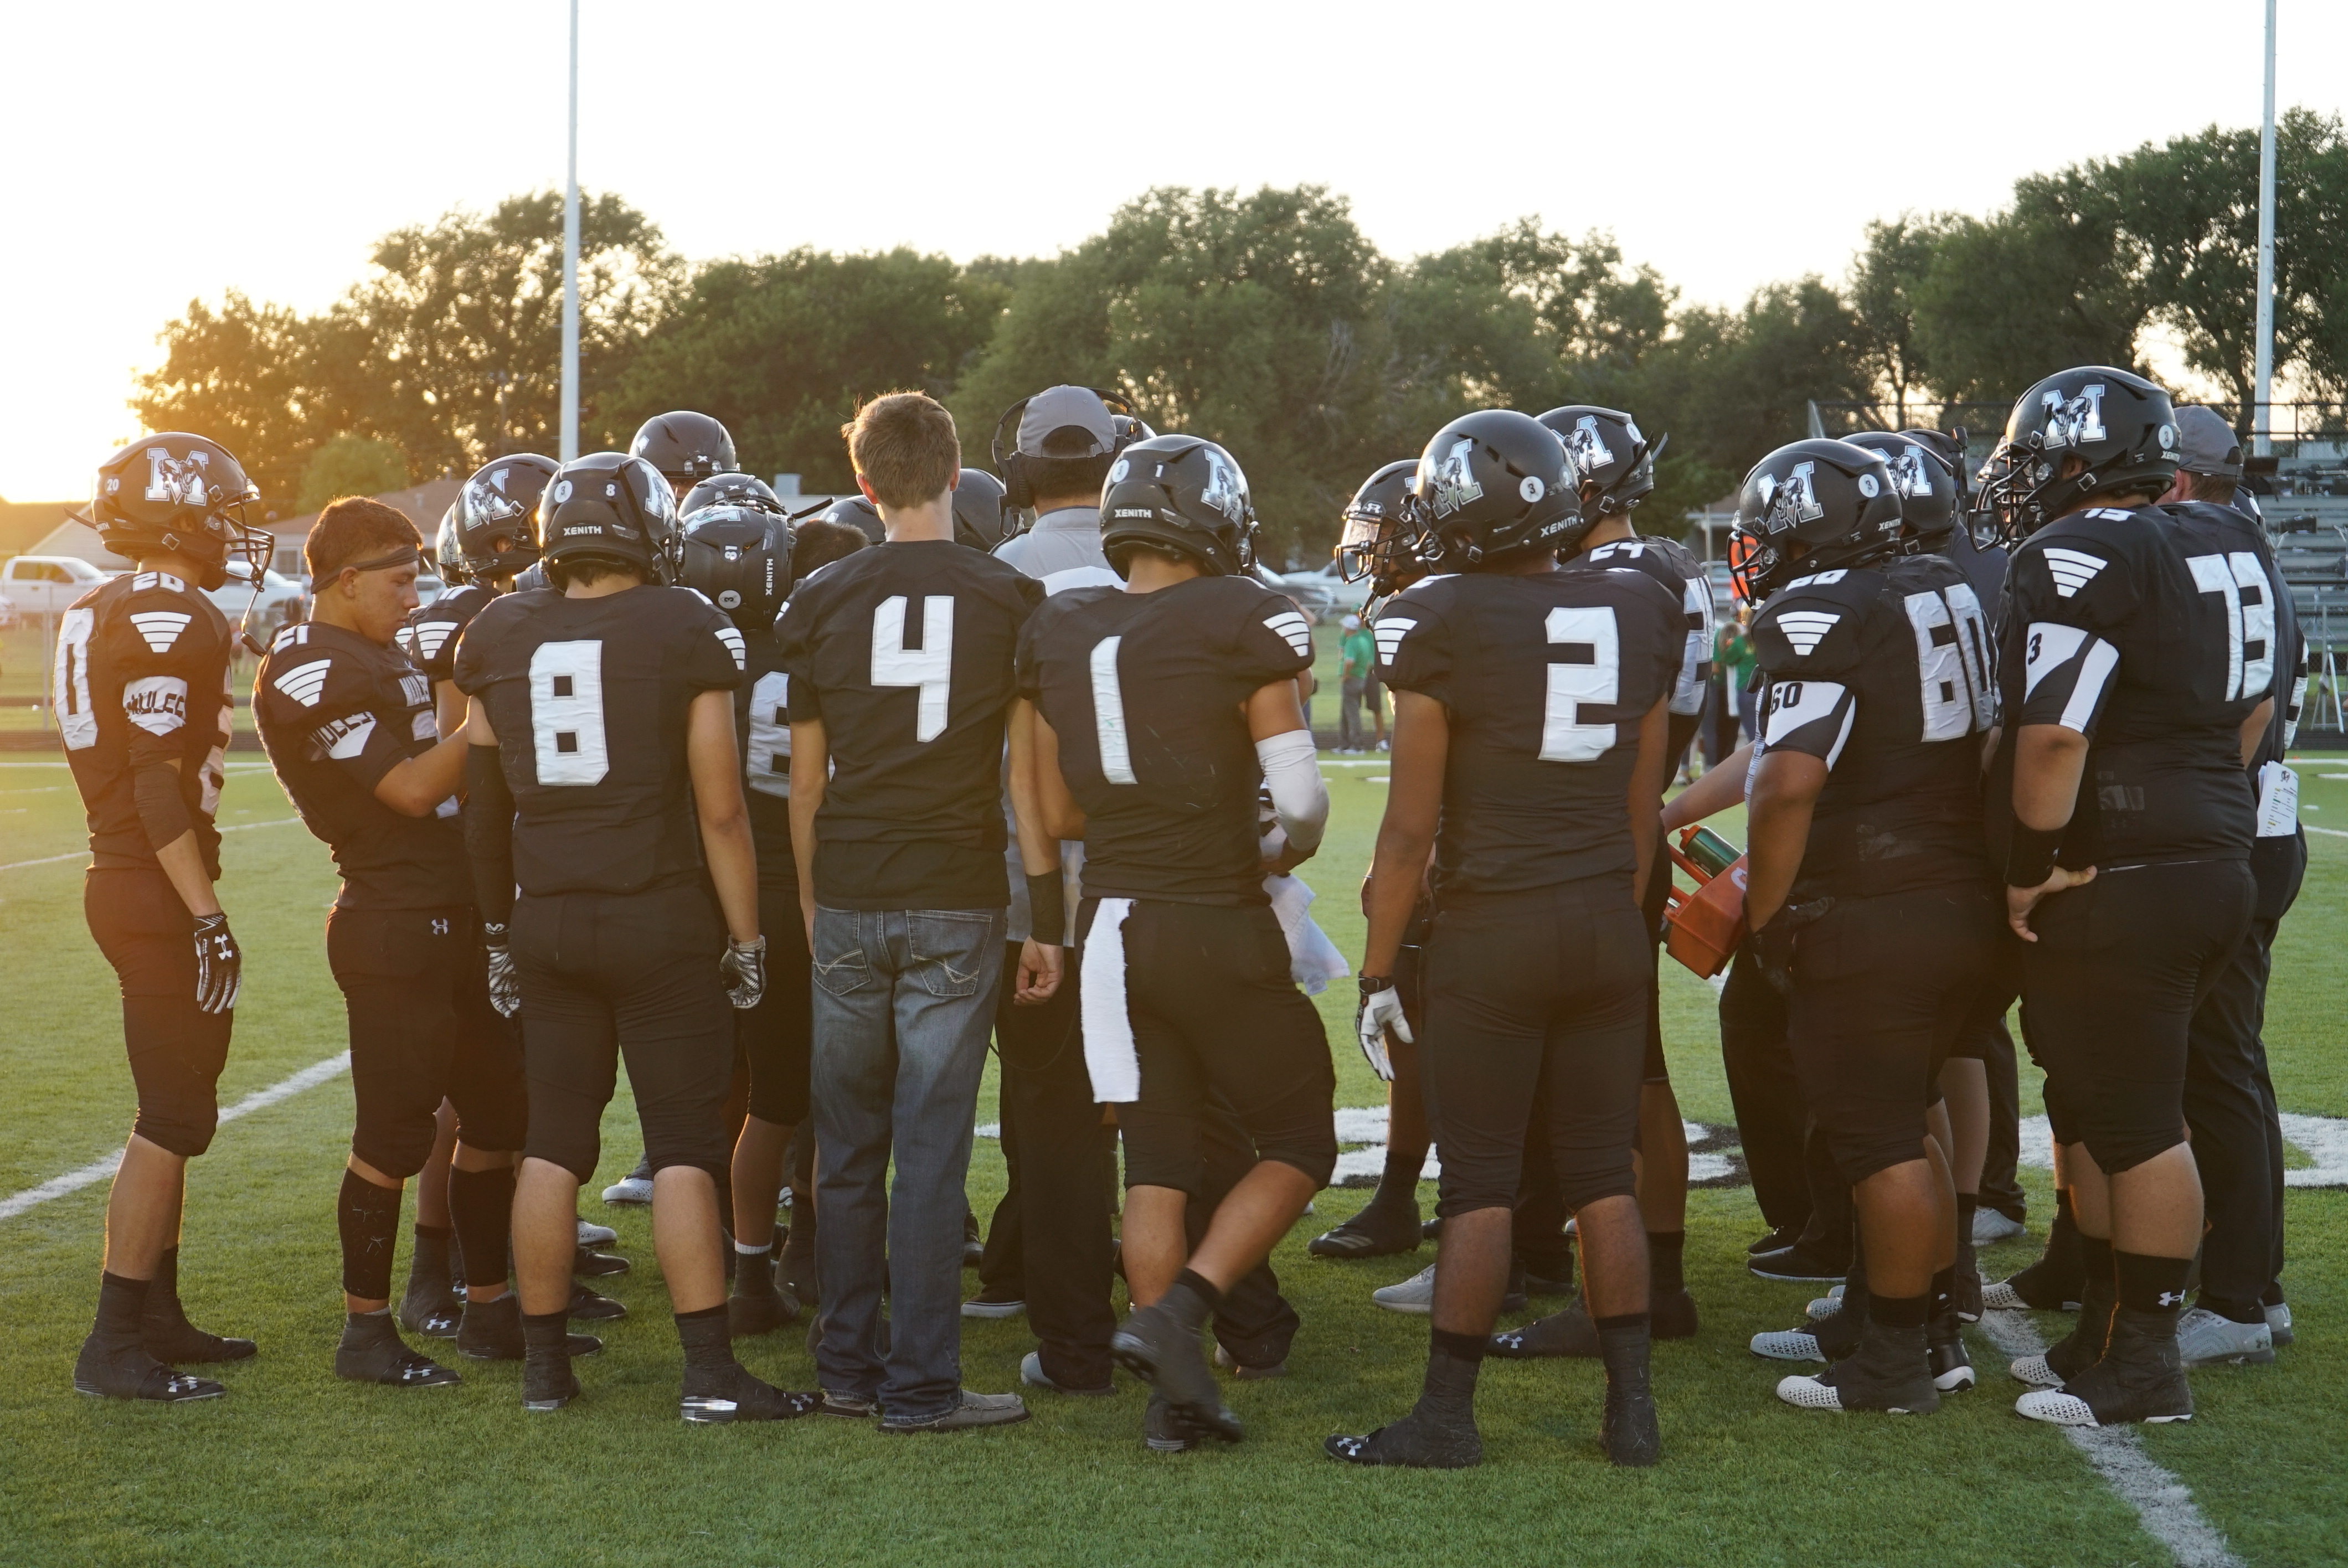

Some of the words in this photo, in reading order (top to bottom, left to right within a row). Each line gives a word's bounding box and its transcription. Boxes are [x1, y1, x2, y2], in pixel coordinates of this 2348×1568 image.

[107, 478, 119, 491] 20
[145, 448, 209, 506] M
[1155, 465, 1163, 477] 1
[606, 484, 615, 497] 8
[1528, 483, 1536, 494] 3
[1115, 508, 1152, 518] XENITH
[1540, 515, 1577, 538] XENITH
[1878, 518, 1901, 531] XENITH
[563, 525, 602, 536] XENITH
[724, 545, 738, 559] 81
[765, 558, 774, 596] XENITH
[2185, 551, 2275, 702] 73
[1904, 582, 1995, 743] 60
[2028, 632, 2042, 666] 3
[871, 595, 955, 742] 4
[1538, 606, 1620, 761] 2
[529, 639, 609, 786] 8
[1090, 636, 1138, 785] 1
[1770, 682, 1804, 716] 60
